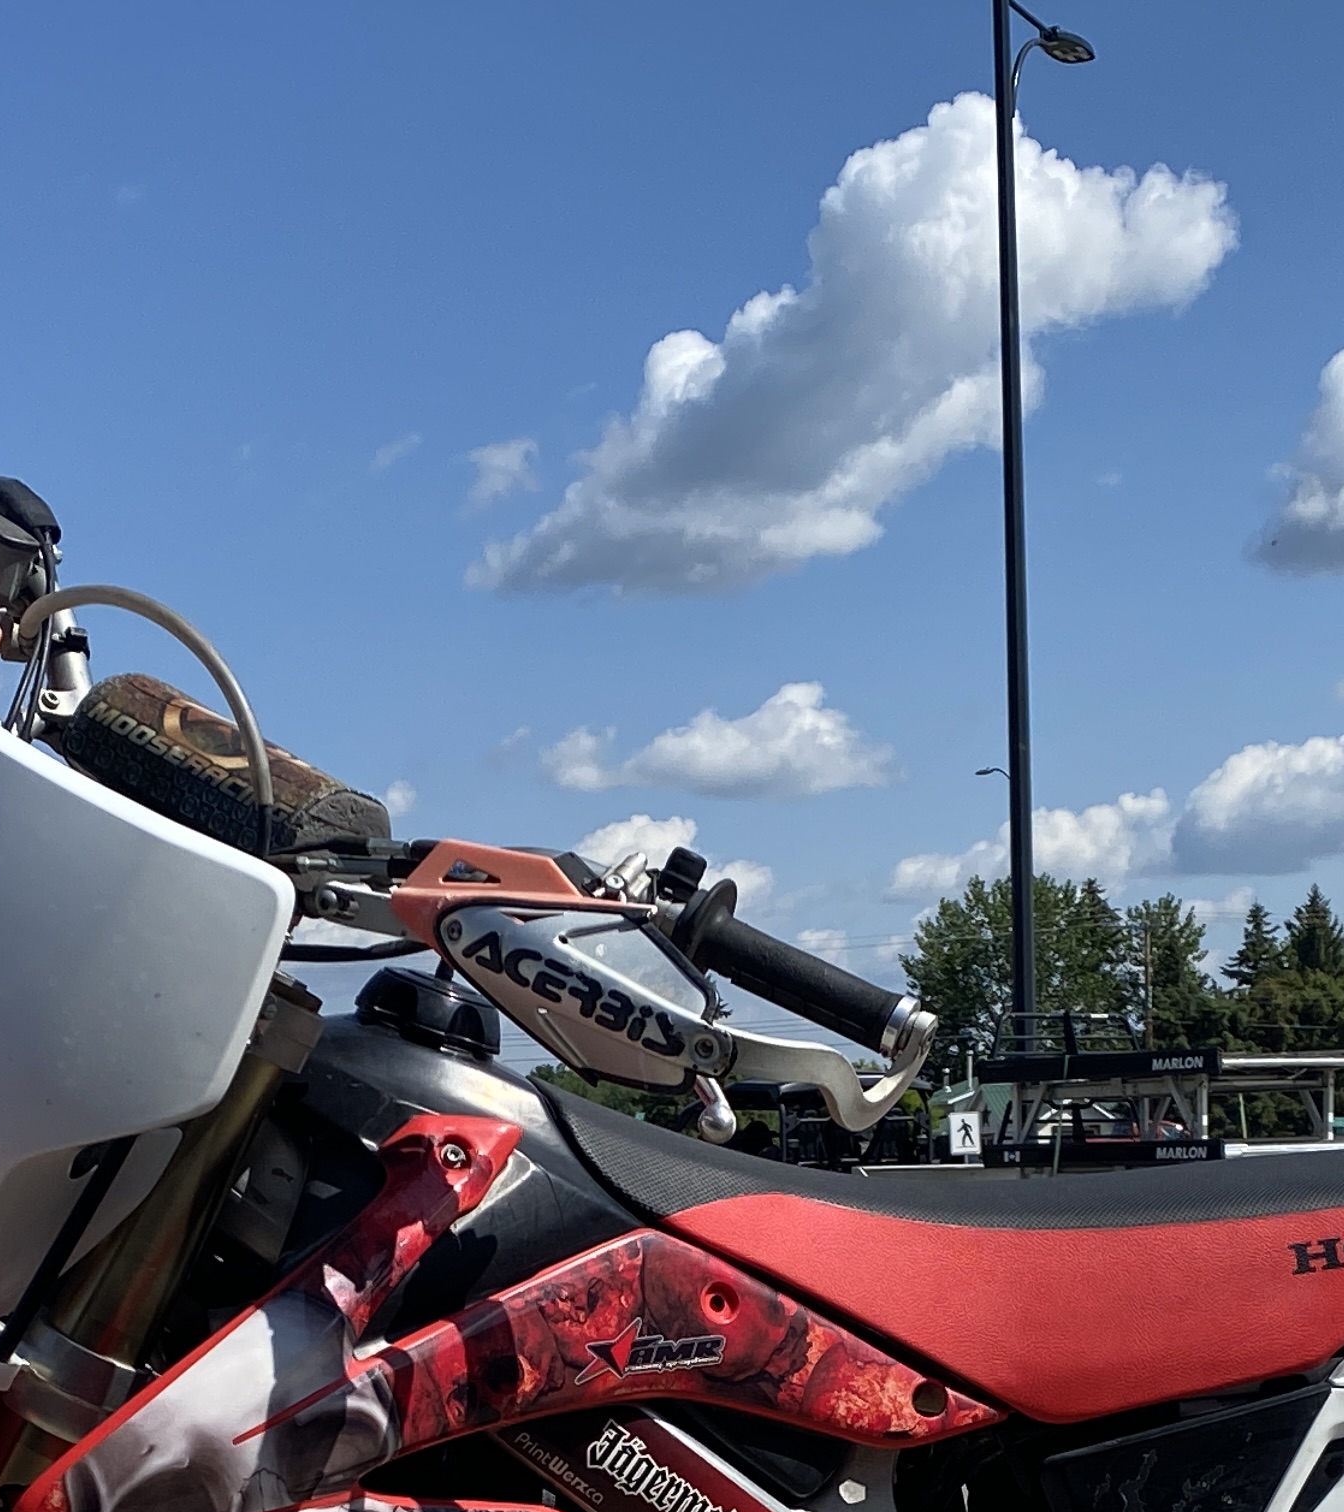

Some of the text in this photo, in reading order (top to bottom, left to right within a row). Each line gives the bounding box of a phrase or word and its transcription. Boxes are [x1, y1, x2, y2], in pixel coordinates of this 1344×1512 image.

[462, 931, 685, 1056] ACERBIS
[1152, 1056, 1204, 1070] MARLON
[1156, 1146, 1207, 1159] MARLON
